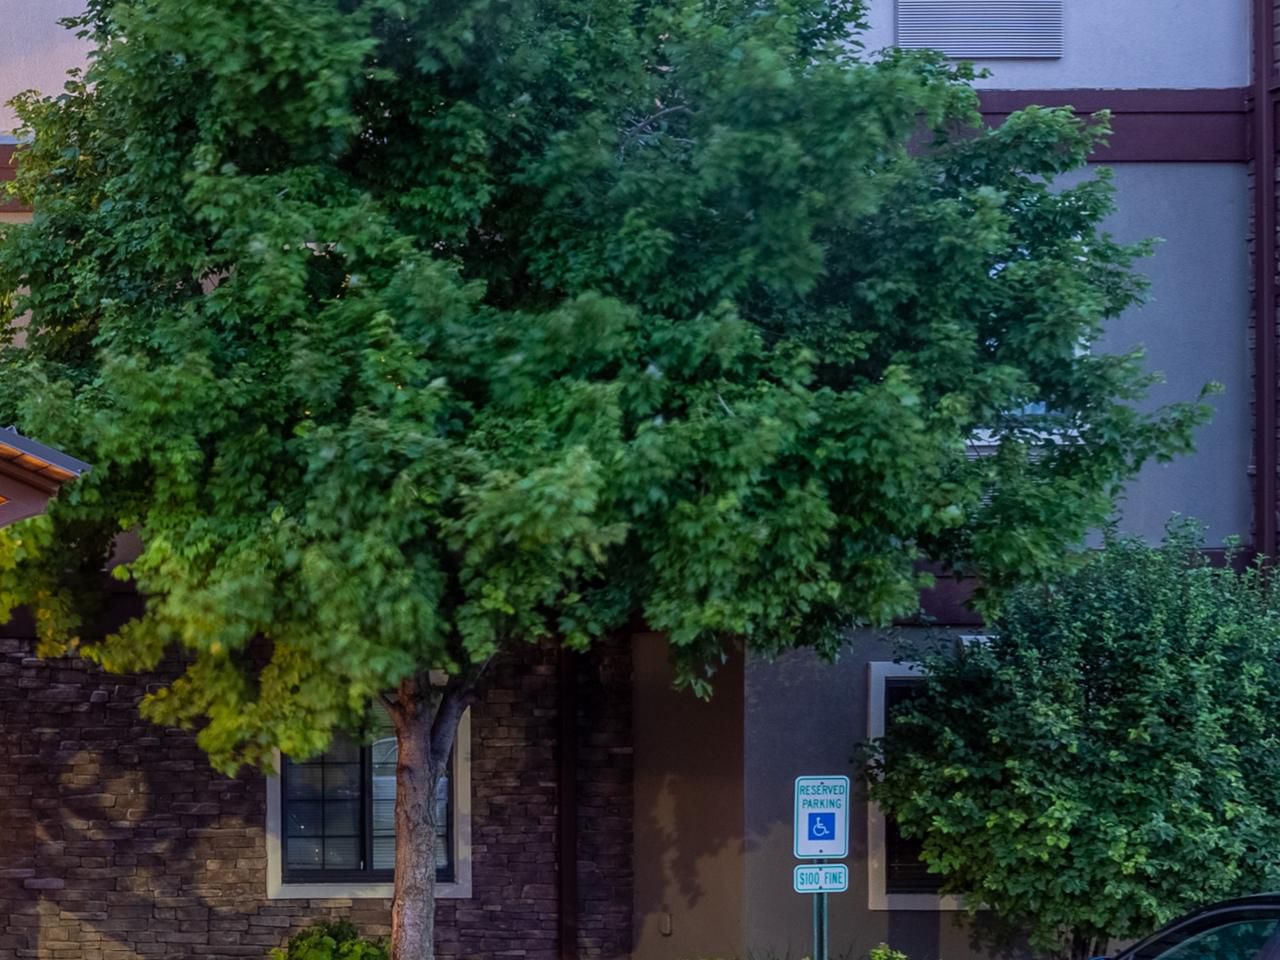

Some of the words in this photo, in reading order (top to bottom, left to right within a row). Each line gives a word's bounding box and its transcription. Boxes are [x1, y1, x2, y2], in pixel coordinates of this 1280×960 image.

[800, 784, 845, 796] RESERVED
[802, 798, 842, 809] PARKING
[799, 872, 820, 886] $100
[824, 871, 843, 884] FINE
